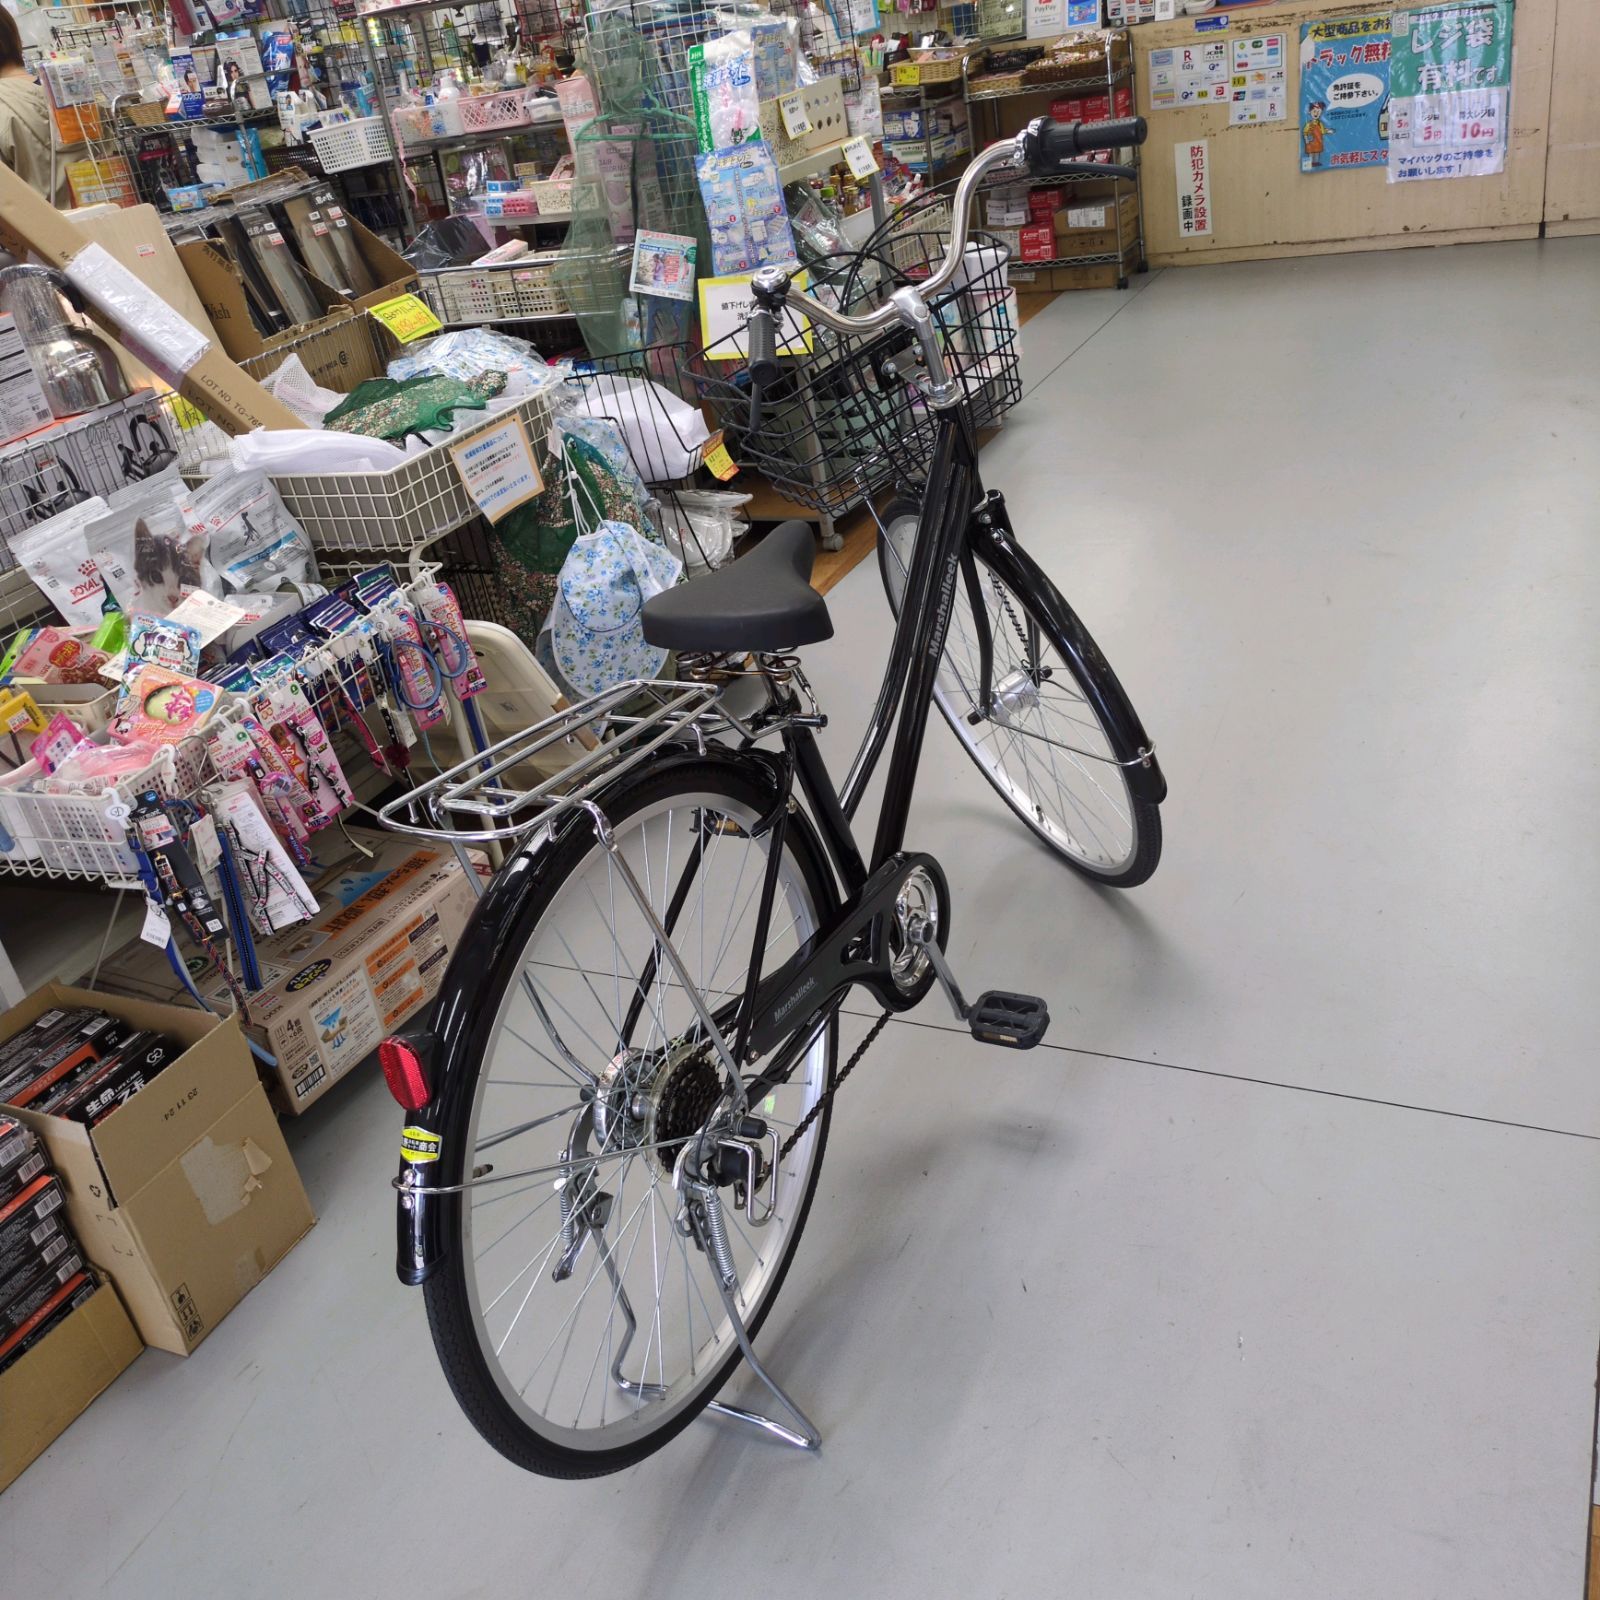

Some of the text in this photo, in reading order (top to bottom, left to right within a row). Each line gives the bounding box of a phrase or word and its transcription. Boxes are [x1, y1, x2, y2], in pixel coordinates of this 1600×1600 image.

[1034, 5, 1056, 13] PayPay
[1411, 17, 1494, 54] レジ袋
[1333, 82, 1361, 91] 免許証を
[1333, 89, 1379, 100] ご持参下さい。
[1423, 126, 1442, 140] 5円
[1460, 121, 1495, 140] 10円
[1189, 146, 1208, 232] 防犯カメラ設置
[1181, 195, 1193, 232] 録画中
[201, 375, 219, 391] LOT
[85, 1087, 116, 1113] 生命
[186, 1087, 199, 1101] 23
[176, 1099, 187, 1110] 11
